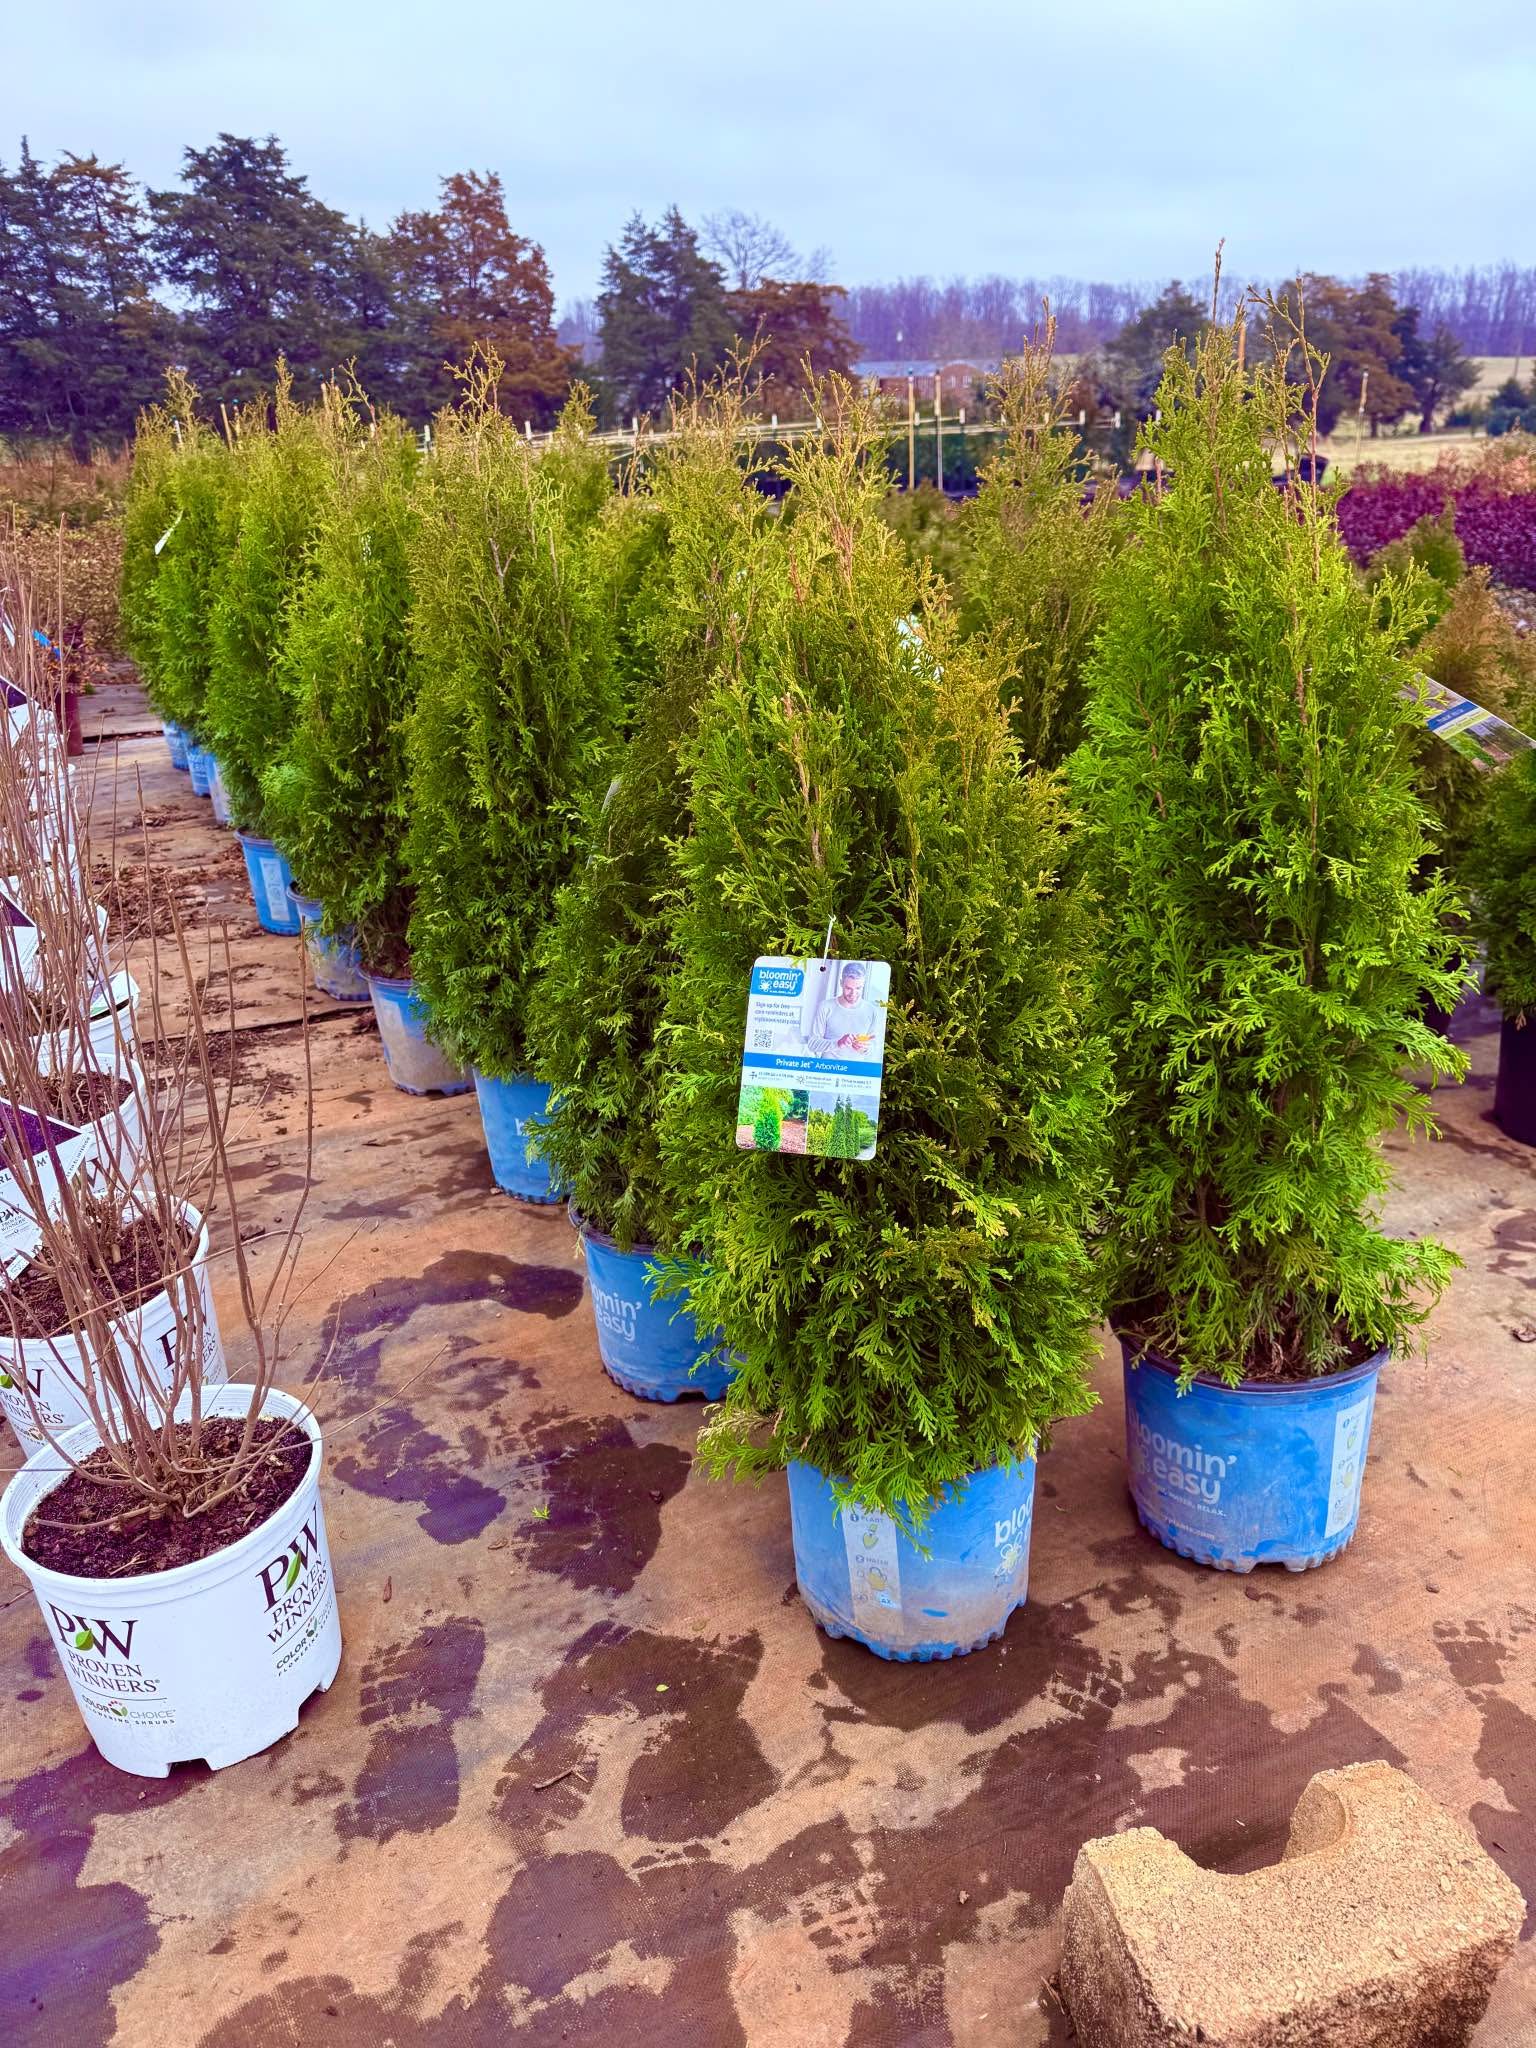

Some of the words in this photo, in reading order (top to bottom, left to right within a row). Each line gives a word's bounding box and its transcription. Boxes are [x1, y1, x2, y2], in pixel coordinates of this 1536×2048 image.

[773, 980, 797, 991] easy
[776, 1058, 799, 1068] Private
[815, 1062, 848, 1072] Arborvitae
[1152, 1457, 1221, 1505] easy
[272, 1554, 323, 1624] PROVEN
[66, 1648, 143, 1677] PROVEN
[276, 1638, 307, 1669] COLOR
[82, 1694, 111, 1713] COLOR
